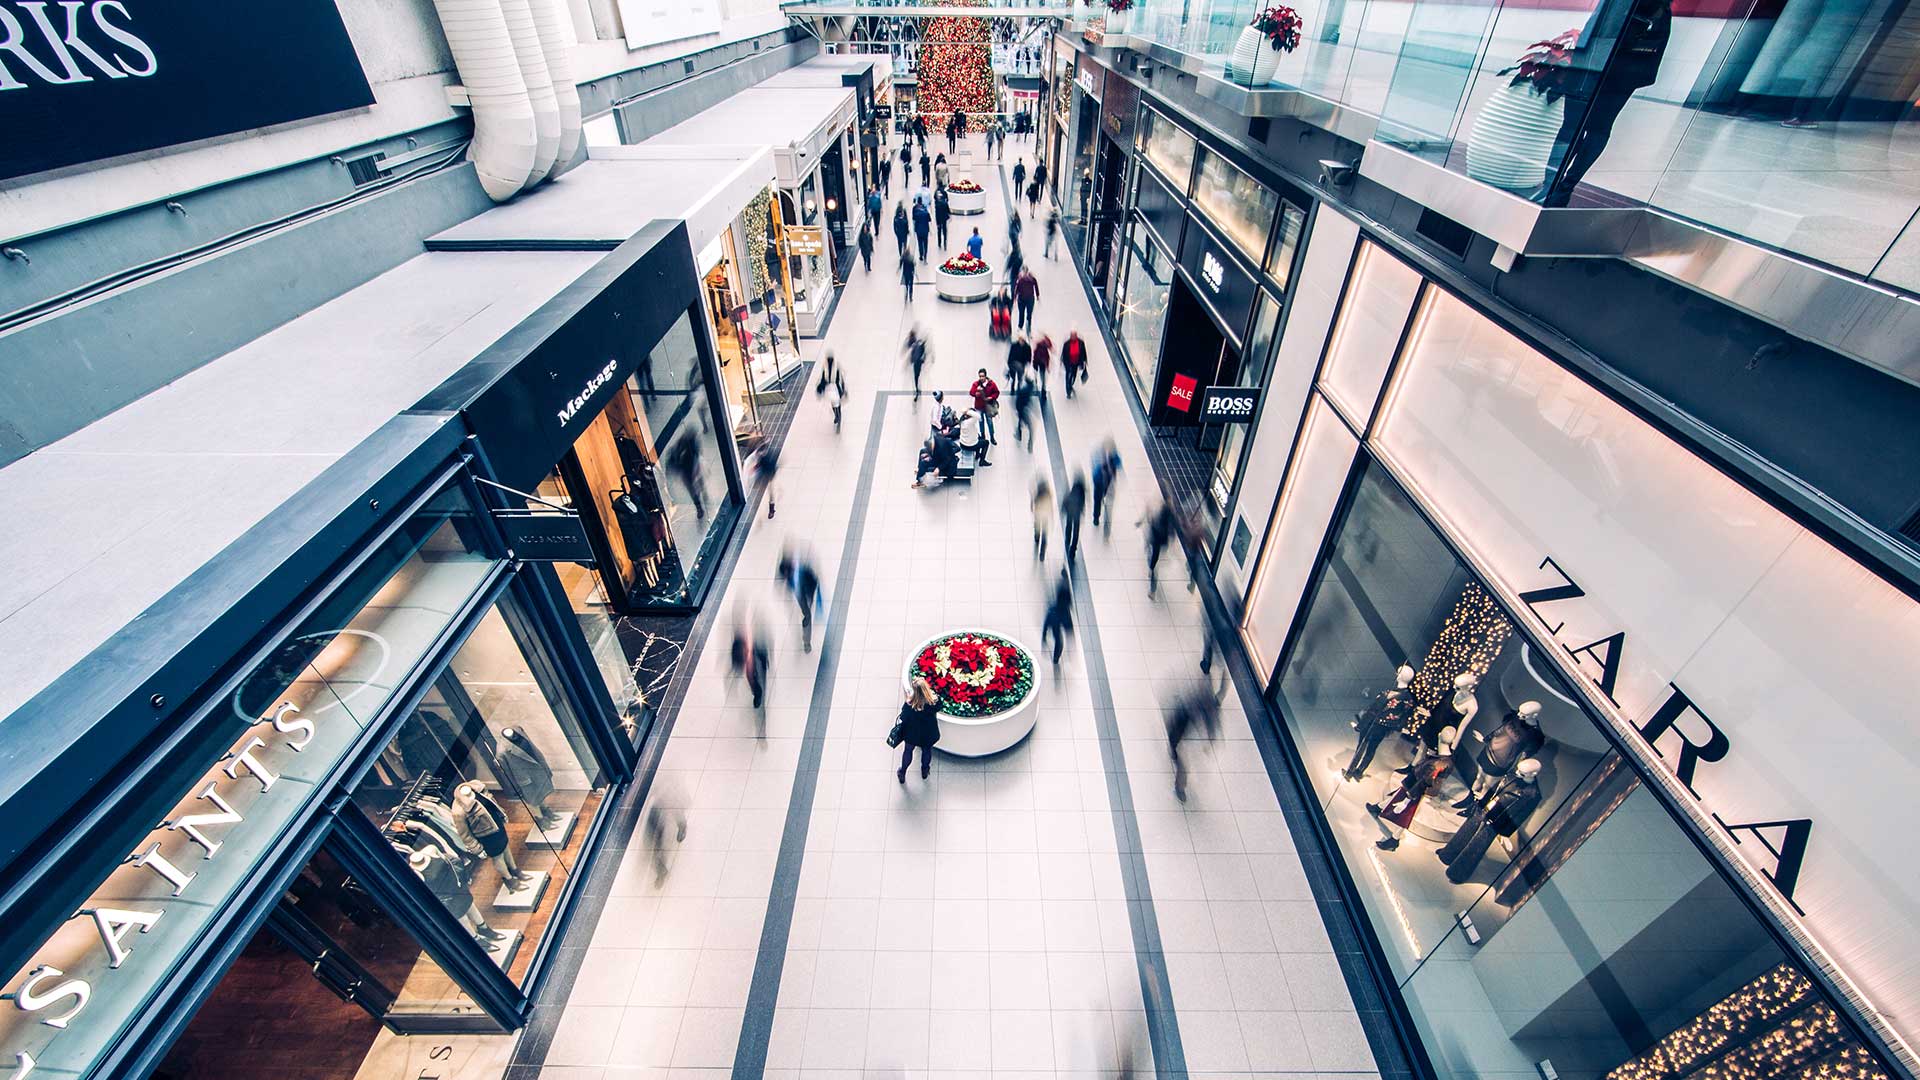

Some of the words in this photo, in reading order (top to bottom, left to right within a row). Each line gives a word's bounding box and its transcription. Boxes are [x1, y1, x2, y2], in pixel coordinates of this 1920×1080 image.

[557, 359, 617, 428] Mackage
[1171, 386, 1193, 401] SALE
[1207, 396, 1254, 411] BOSS
[1518, 556, 1813, 917] ZARA
